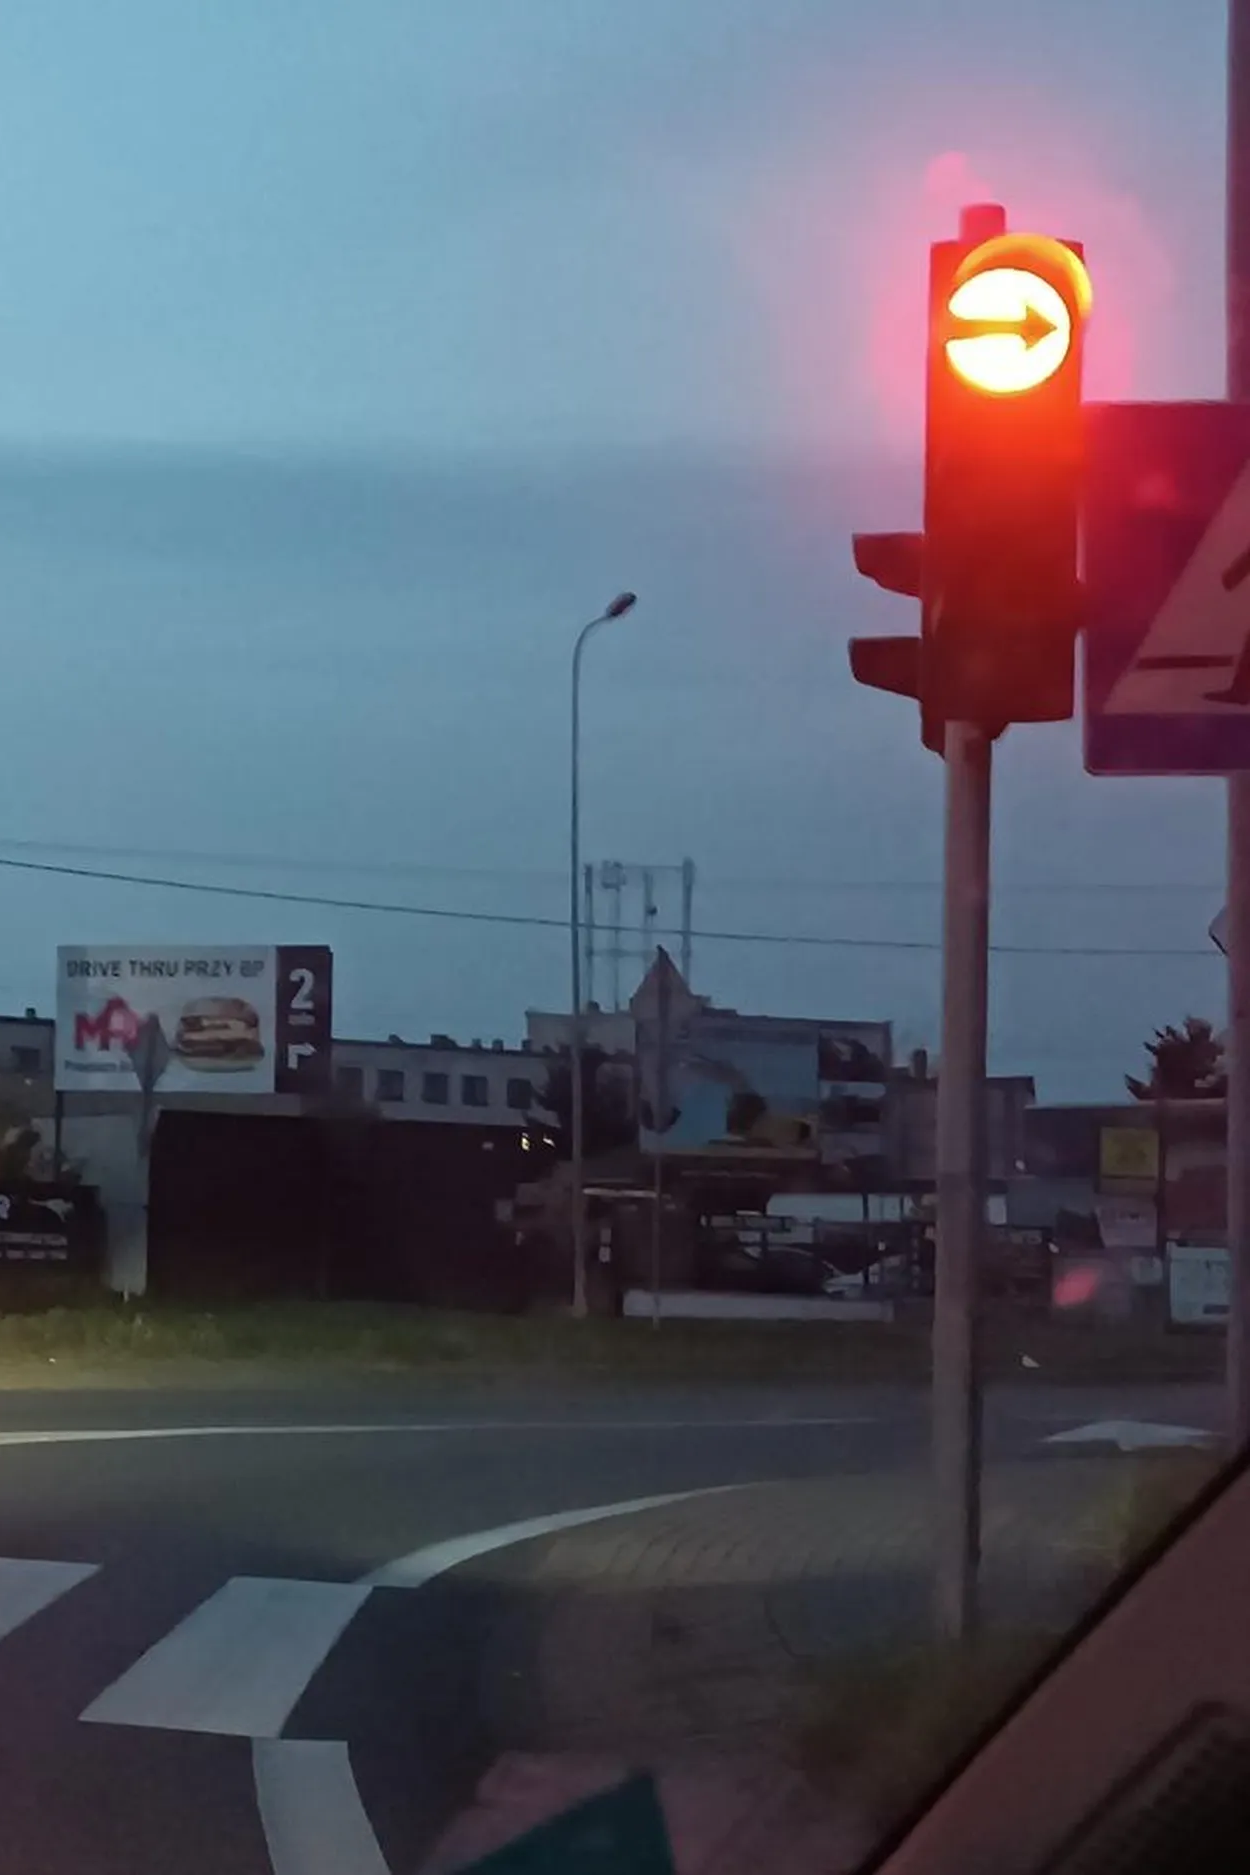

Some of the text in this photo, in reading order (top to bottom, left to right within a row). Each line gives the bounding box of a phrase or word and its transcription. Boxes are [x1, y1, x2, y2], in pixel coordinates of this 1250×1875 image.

[66, 959, 121, 979] DRIVE
[129, 959, 179, 979] THRU
[184, 959, 232, 979] PRZY
